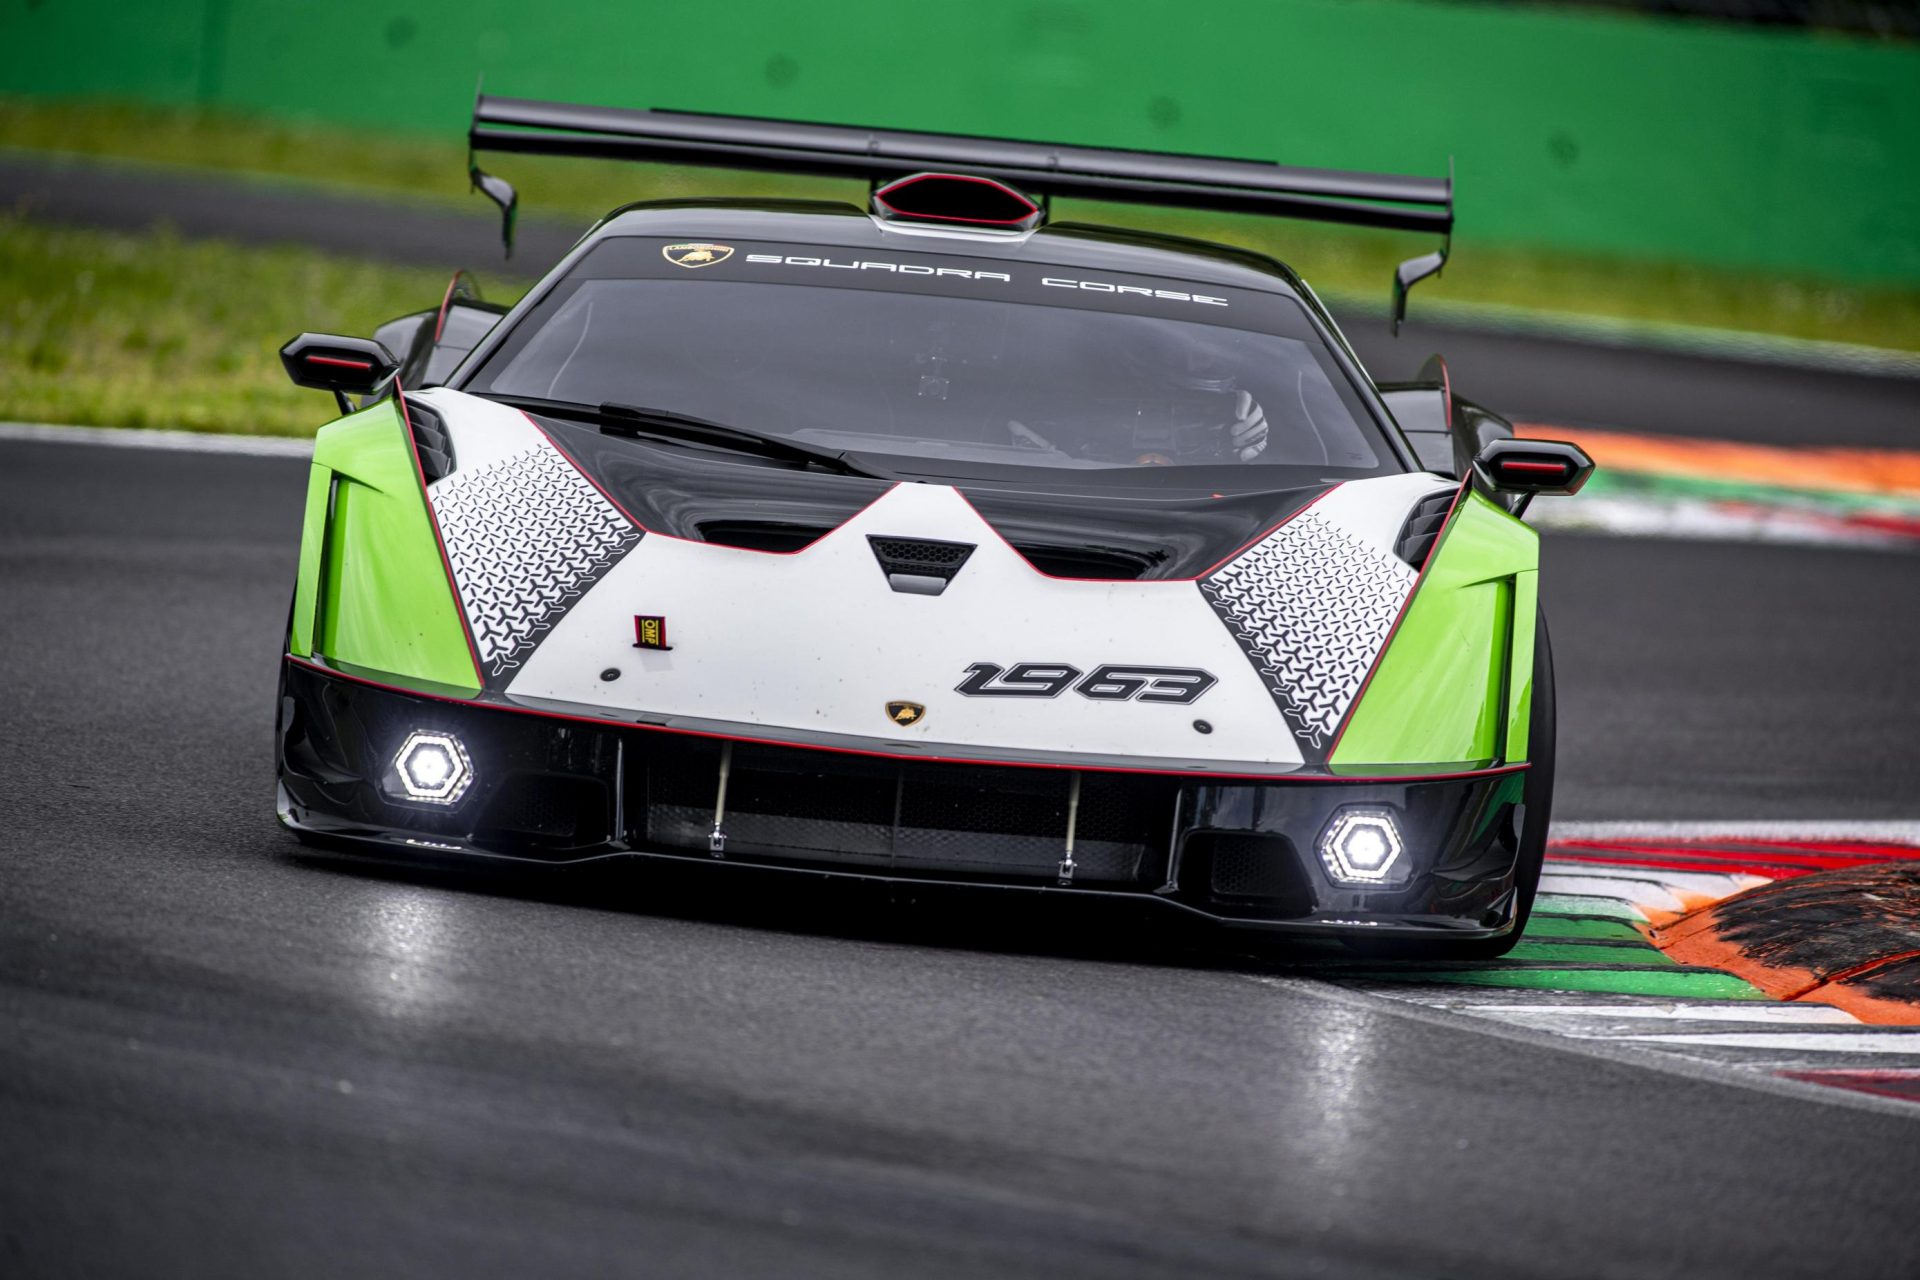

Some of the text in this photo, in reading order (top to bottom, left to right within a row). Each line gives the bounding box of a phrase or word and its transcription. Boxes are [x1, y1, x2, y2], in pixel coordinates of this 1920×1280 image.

[746, 254, 1228, 306] SQUADRA CORSE
[644, 619, 656, 645] OMP
[954, 662, 1218, 705] 1963
